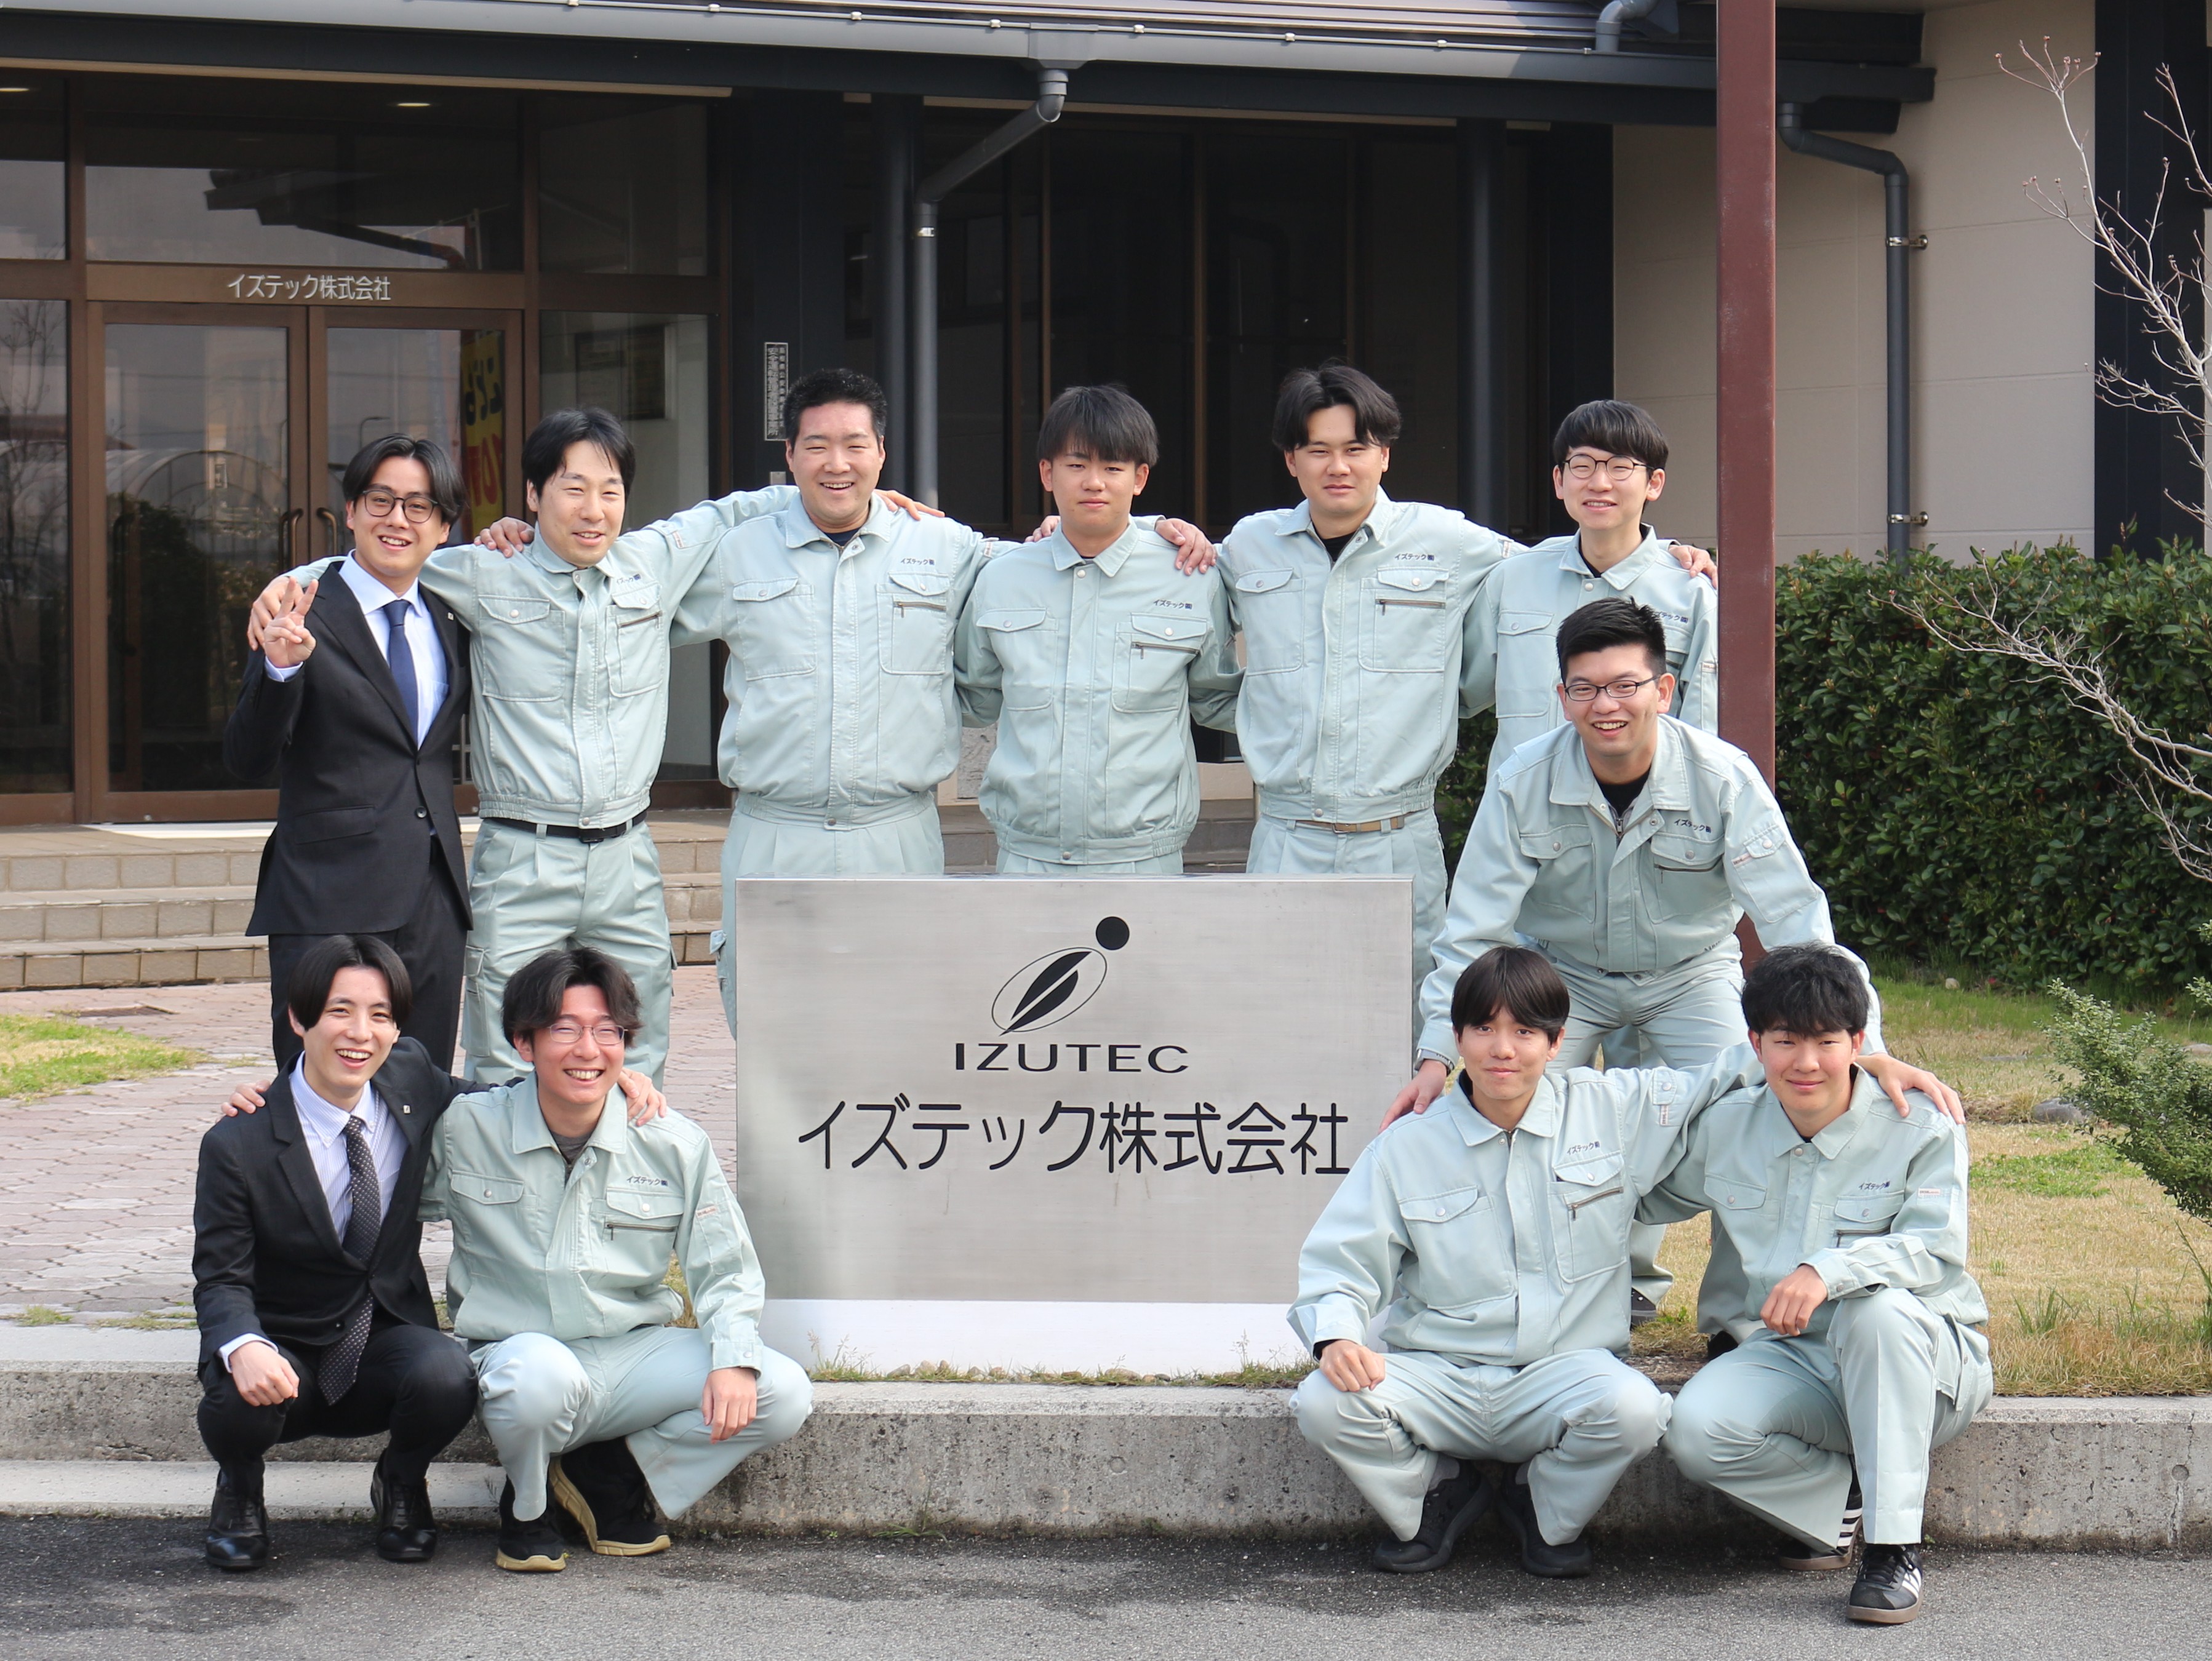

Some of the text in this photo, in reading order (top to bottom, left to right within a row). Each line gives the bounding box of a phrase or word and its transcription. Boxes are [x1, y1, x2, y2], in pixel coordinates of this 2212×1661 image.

[227, 274, 391, 301] イズテック株式会社
[956, 1043, 1189, 1074] IZUTEC
[798, 1093, 1349, 1176] イズテック株式会社
